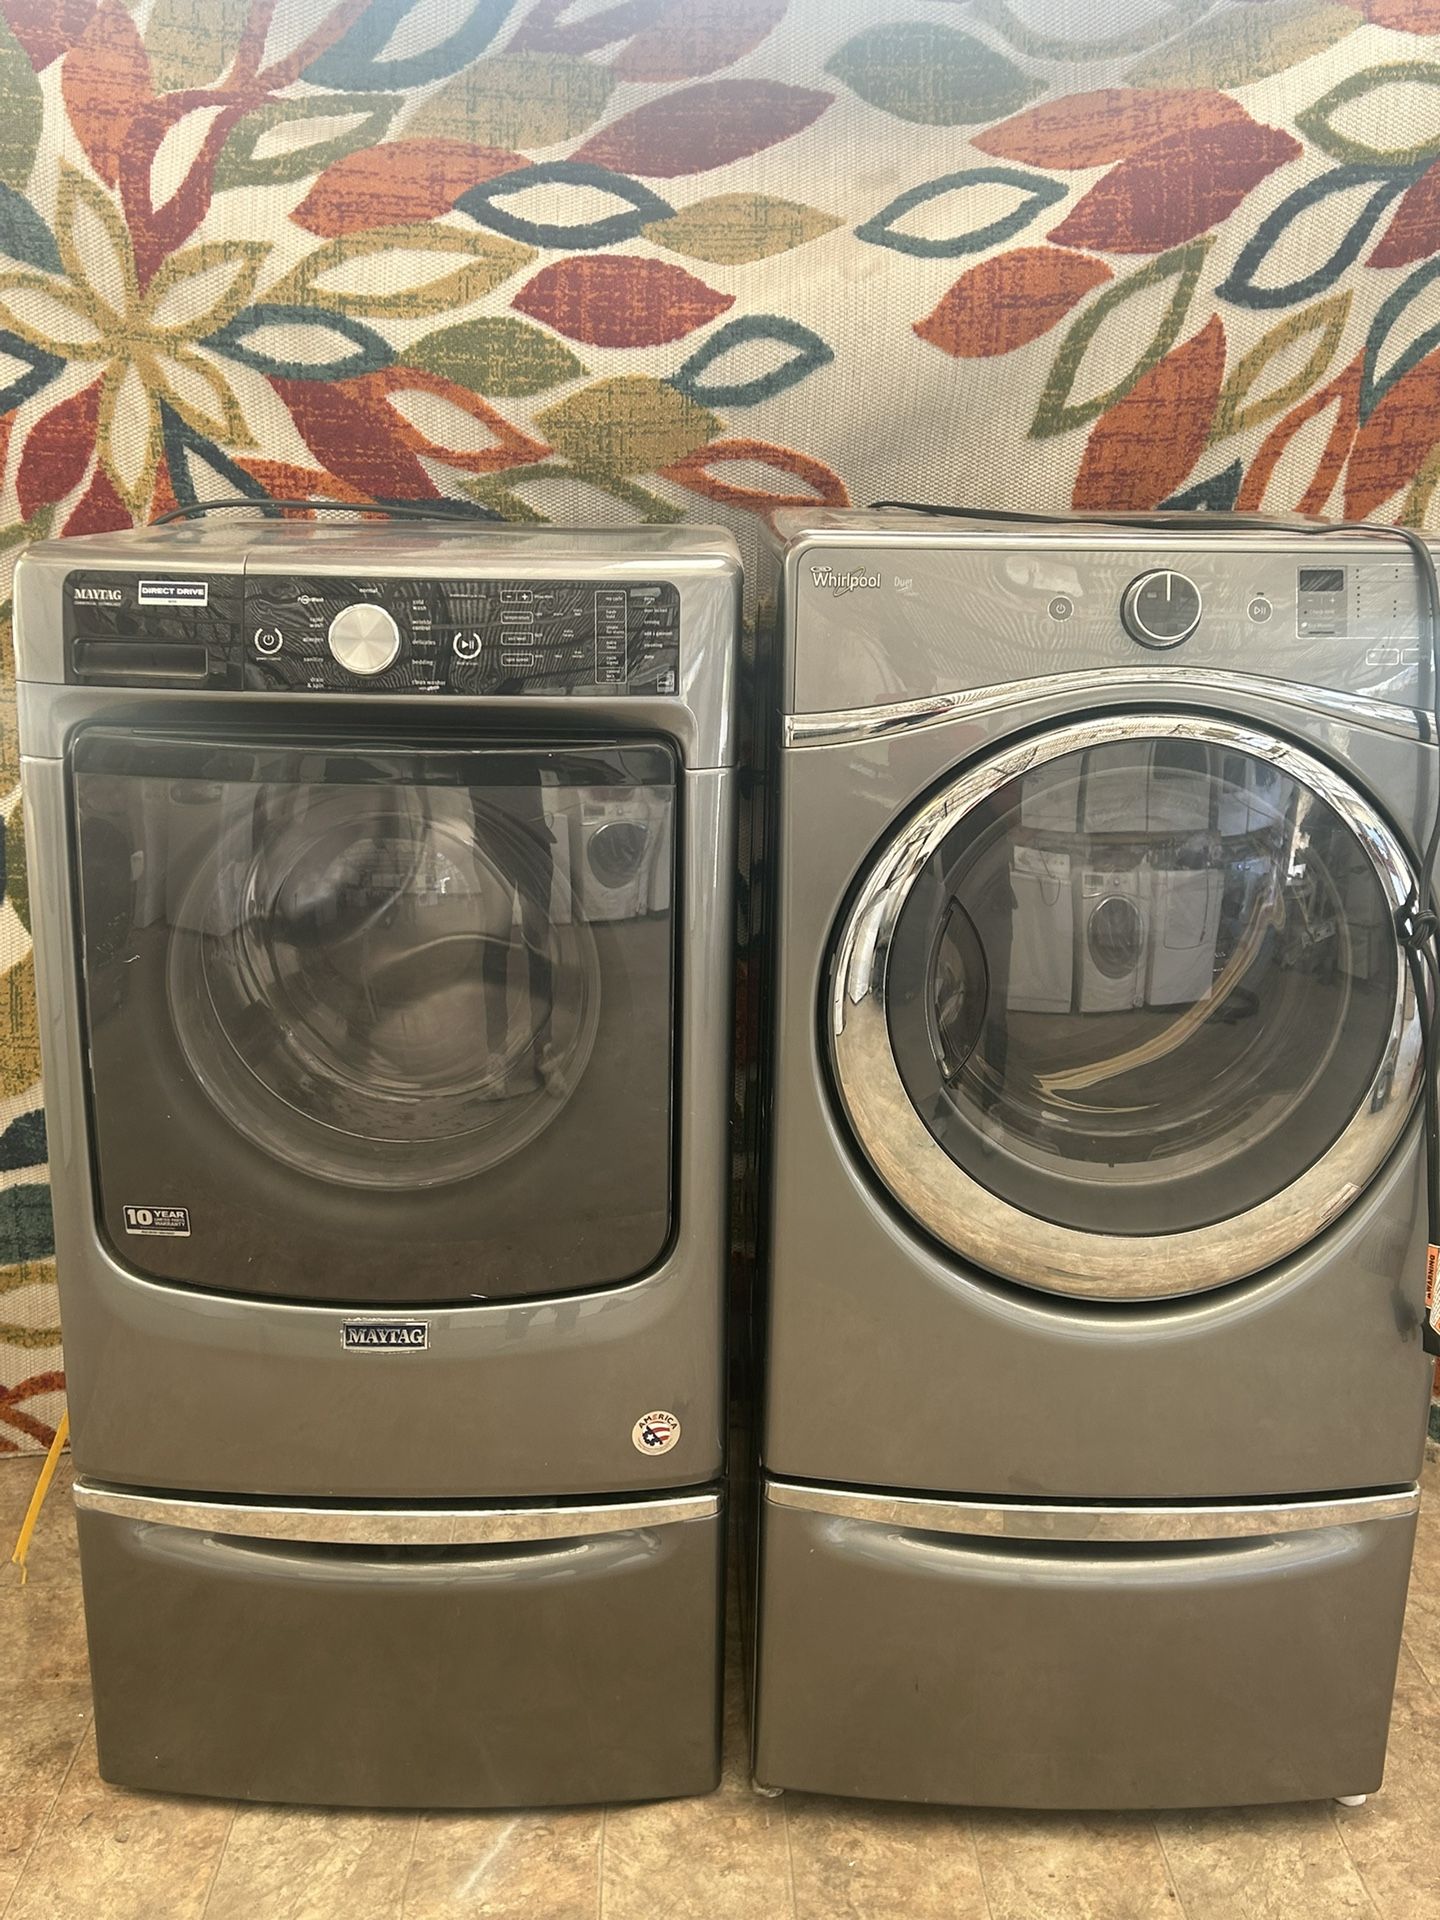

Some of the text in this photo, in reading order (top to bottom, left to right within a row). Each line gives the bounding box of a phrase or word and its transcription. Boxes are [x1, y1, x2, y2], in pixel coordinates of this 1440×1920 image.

[812, 572, 880, 591] Whirlpool
[74, 588, 121, 600] MAYTAG
[141, 587, 174, 595] DIRECT
[127, 1209, 153, 1226] 10
[154, 1210, 185, 1218] YEAR
[1427, 1254, 1435, 1293] WARNING
[346, 1329, 424, 1344] MAYTAG
[639, 1413, 678, 1430] AMERICA
